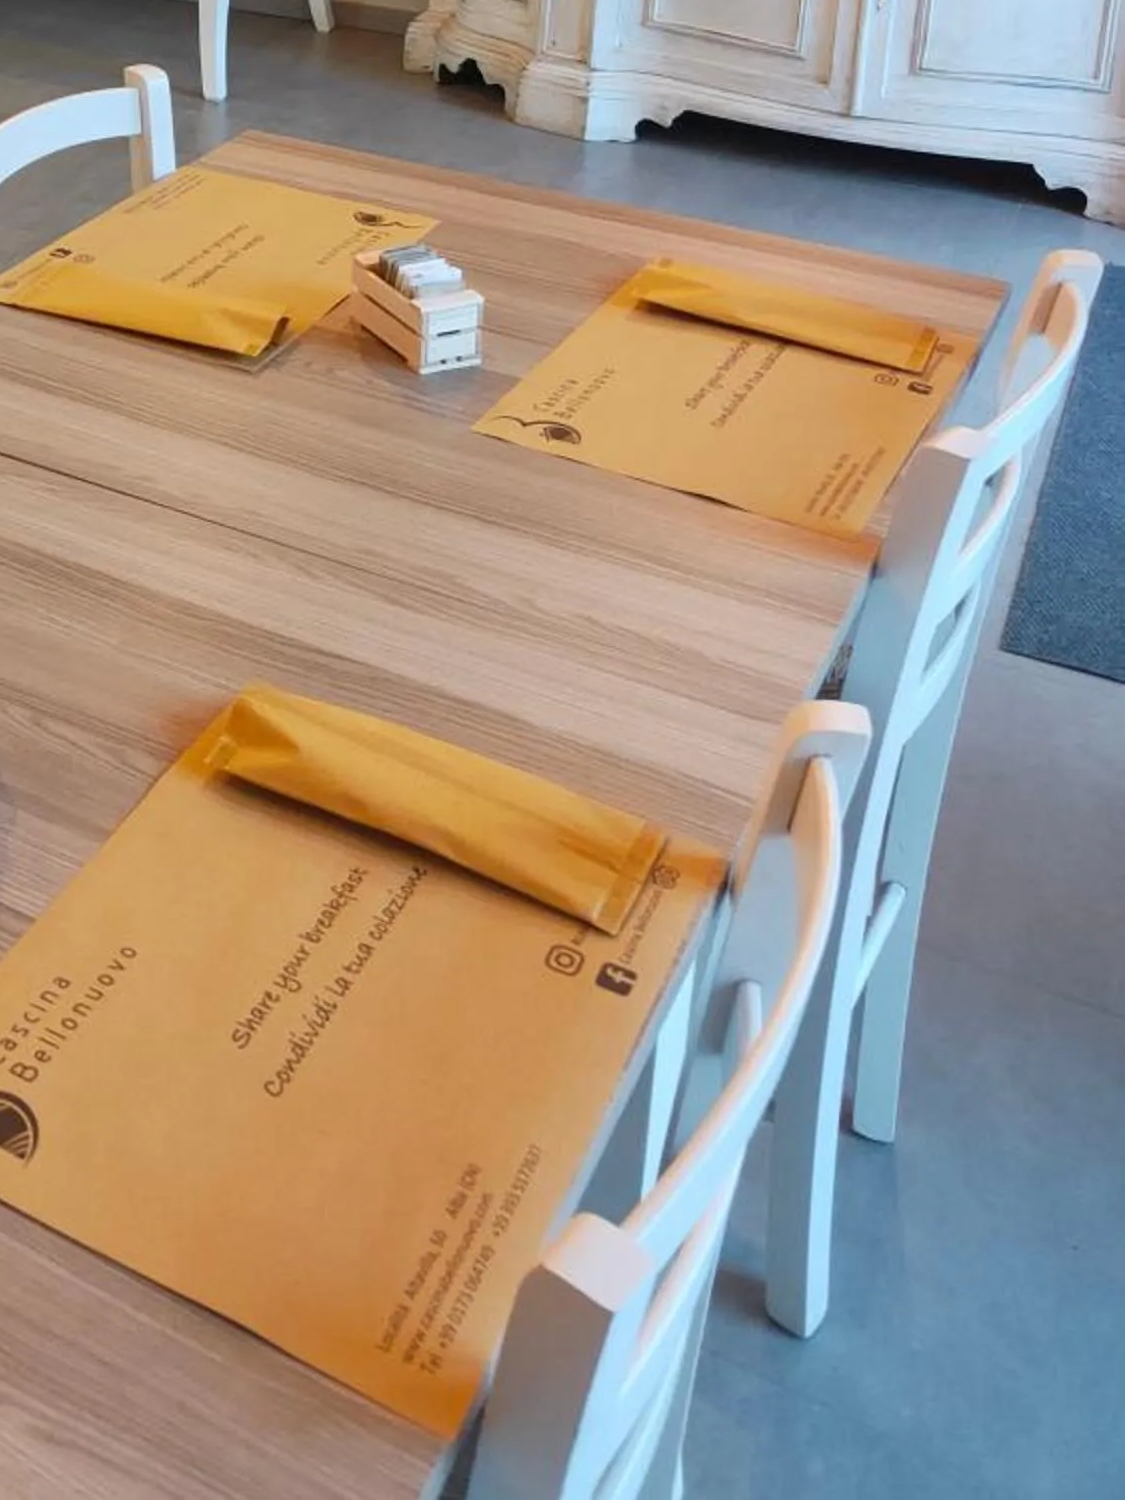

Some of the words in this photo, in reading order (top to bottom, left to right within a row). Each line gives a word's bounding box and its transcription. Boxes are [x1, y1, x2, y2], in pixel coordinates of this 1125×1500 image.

[8, 946, 138, 1083] Bellonuovo
[231, 990, 281, 1050] Share
[274, 944, 311, 993] your
[299, 866, 369, 945] breakfast
[263, 995, 338, 1098] Condividi
[343, 942, 375, 975] tua
[368, 865, 428, 941] colazione
